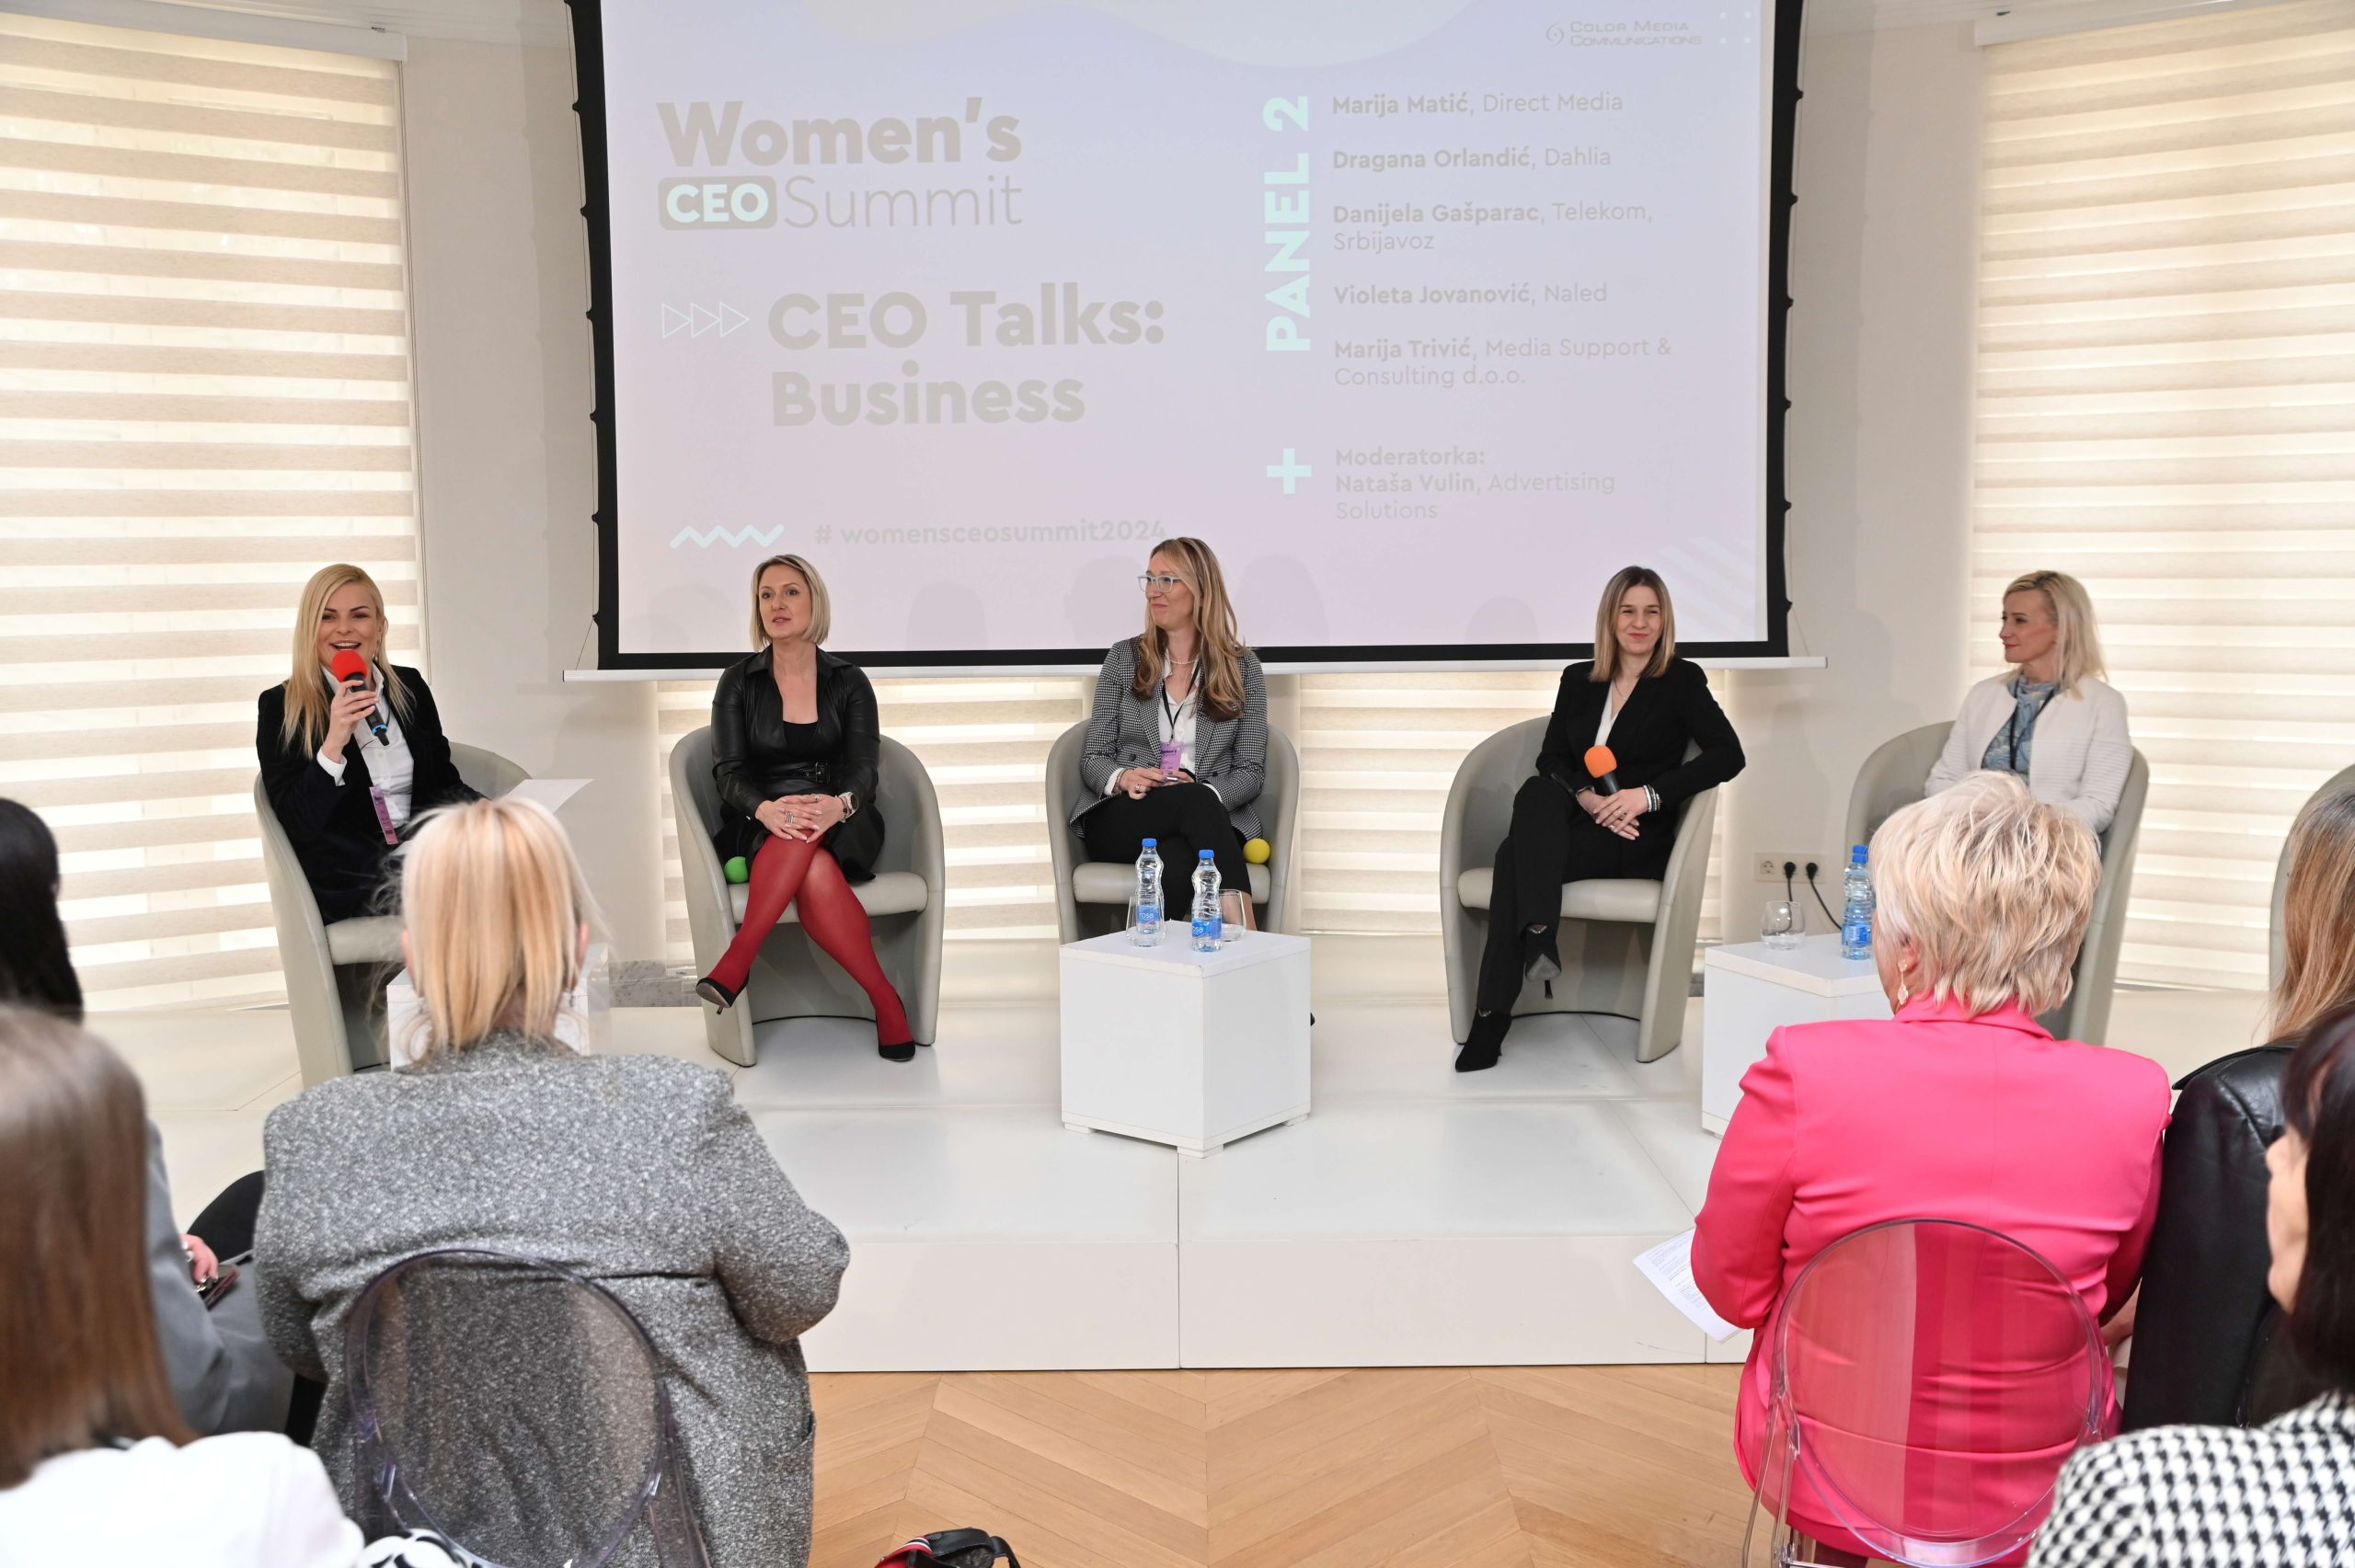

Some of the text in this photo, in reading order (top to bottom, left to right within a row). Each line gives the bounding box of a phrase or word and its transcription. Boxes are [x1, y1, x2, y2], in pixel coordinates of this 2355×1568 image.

[1569, 20, 1690, 33] COLOR MEDIA
[1569, 35, 1702, 47] COMMUNICATIONS
[1332, 92, 1624, 118] Marija Matić, Direct Media
[655, 97, 1023, 167] Women's
[1333, 145, 1611, 173] Dragana Orlandić, Dahlia
[666, 175, 1023, 229] CEO Summit
[1333, 201, 1653, 226] Danijela Gašparac, Telekom,
[1262, 95, 1311, 351] PANEL 2
[1333, 232, 1435, 254] Srbijavoz
[1333, 282, 1608, 305] Violeta Jovanović, Naled
[767, 281, 1165, 350] CEO Talks:
[1334, 337, 1672, 361] Marija Trivić, Media Support &
[1334, 365, 1526, 387] Consulting d.o.o.
[772, 360, 1086, 427] Business
[1335, 446, 1485, 466] Moderatorka:
[1335, 472, 1615, 495] Nataša Vulin, Advertising
[1335, 500, 1439, 520] Solutions
[840, 519, 1166, 545] womensceosummit2024
